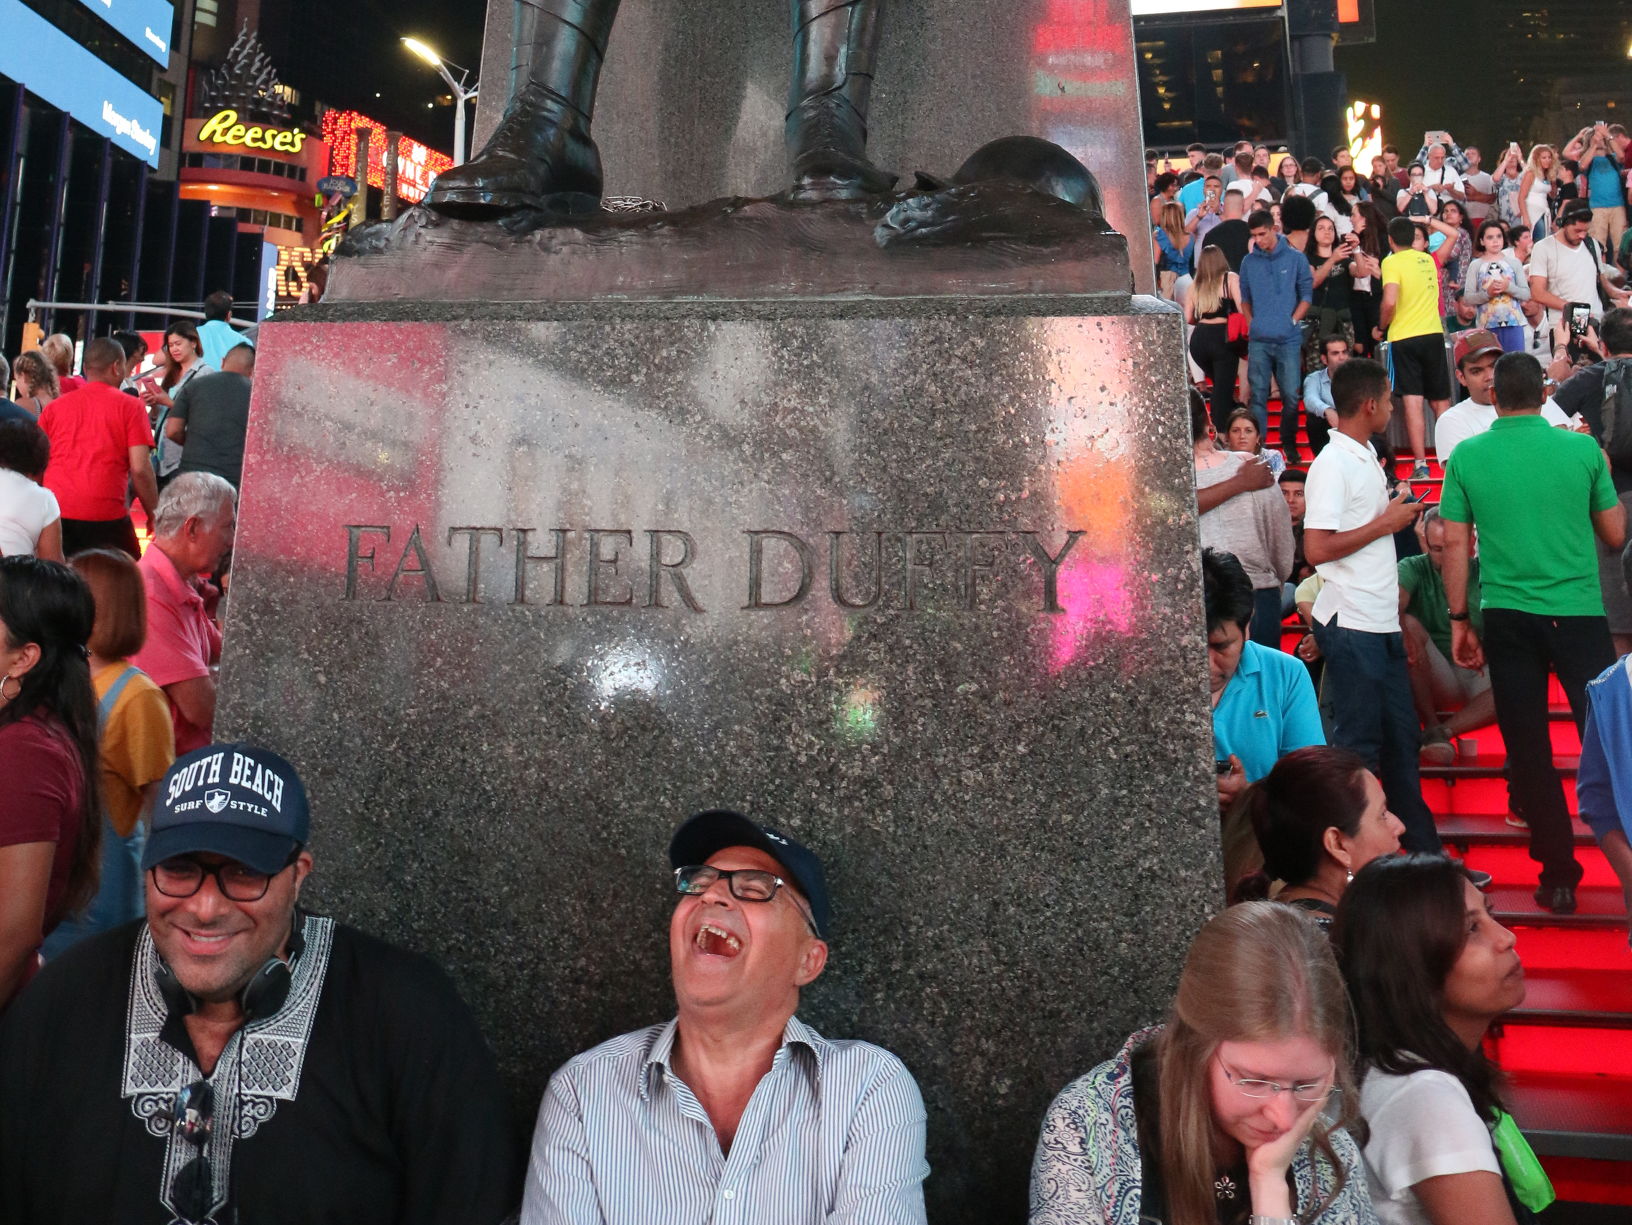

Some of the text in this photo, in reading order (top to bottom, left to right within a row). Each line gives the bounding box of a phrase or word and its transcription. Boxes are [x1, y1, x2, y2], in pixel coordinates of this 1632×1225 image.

[199, 109, 306, 154] Reese's
[341, 522, 1087, 615] FATHER DUFFY
[166, 752, 284, 813] SOUTH BEACH
[174, 799, 268, 817] SURF STYLE
